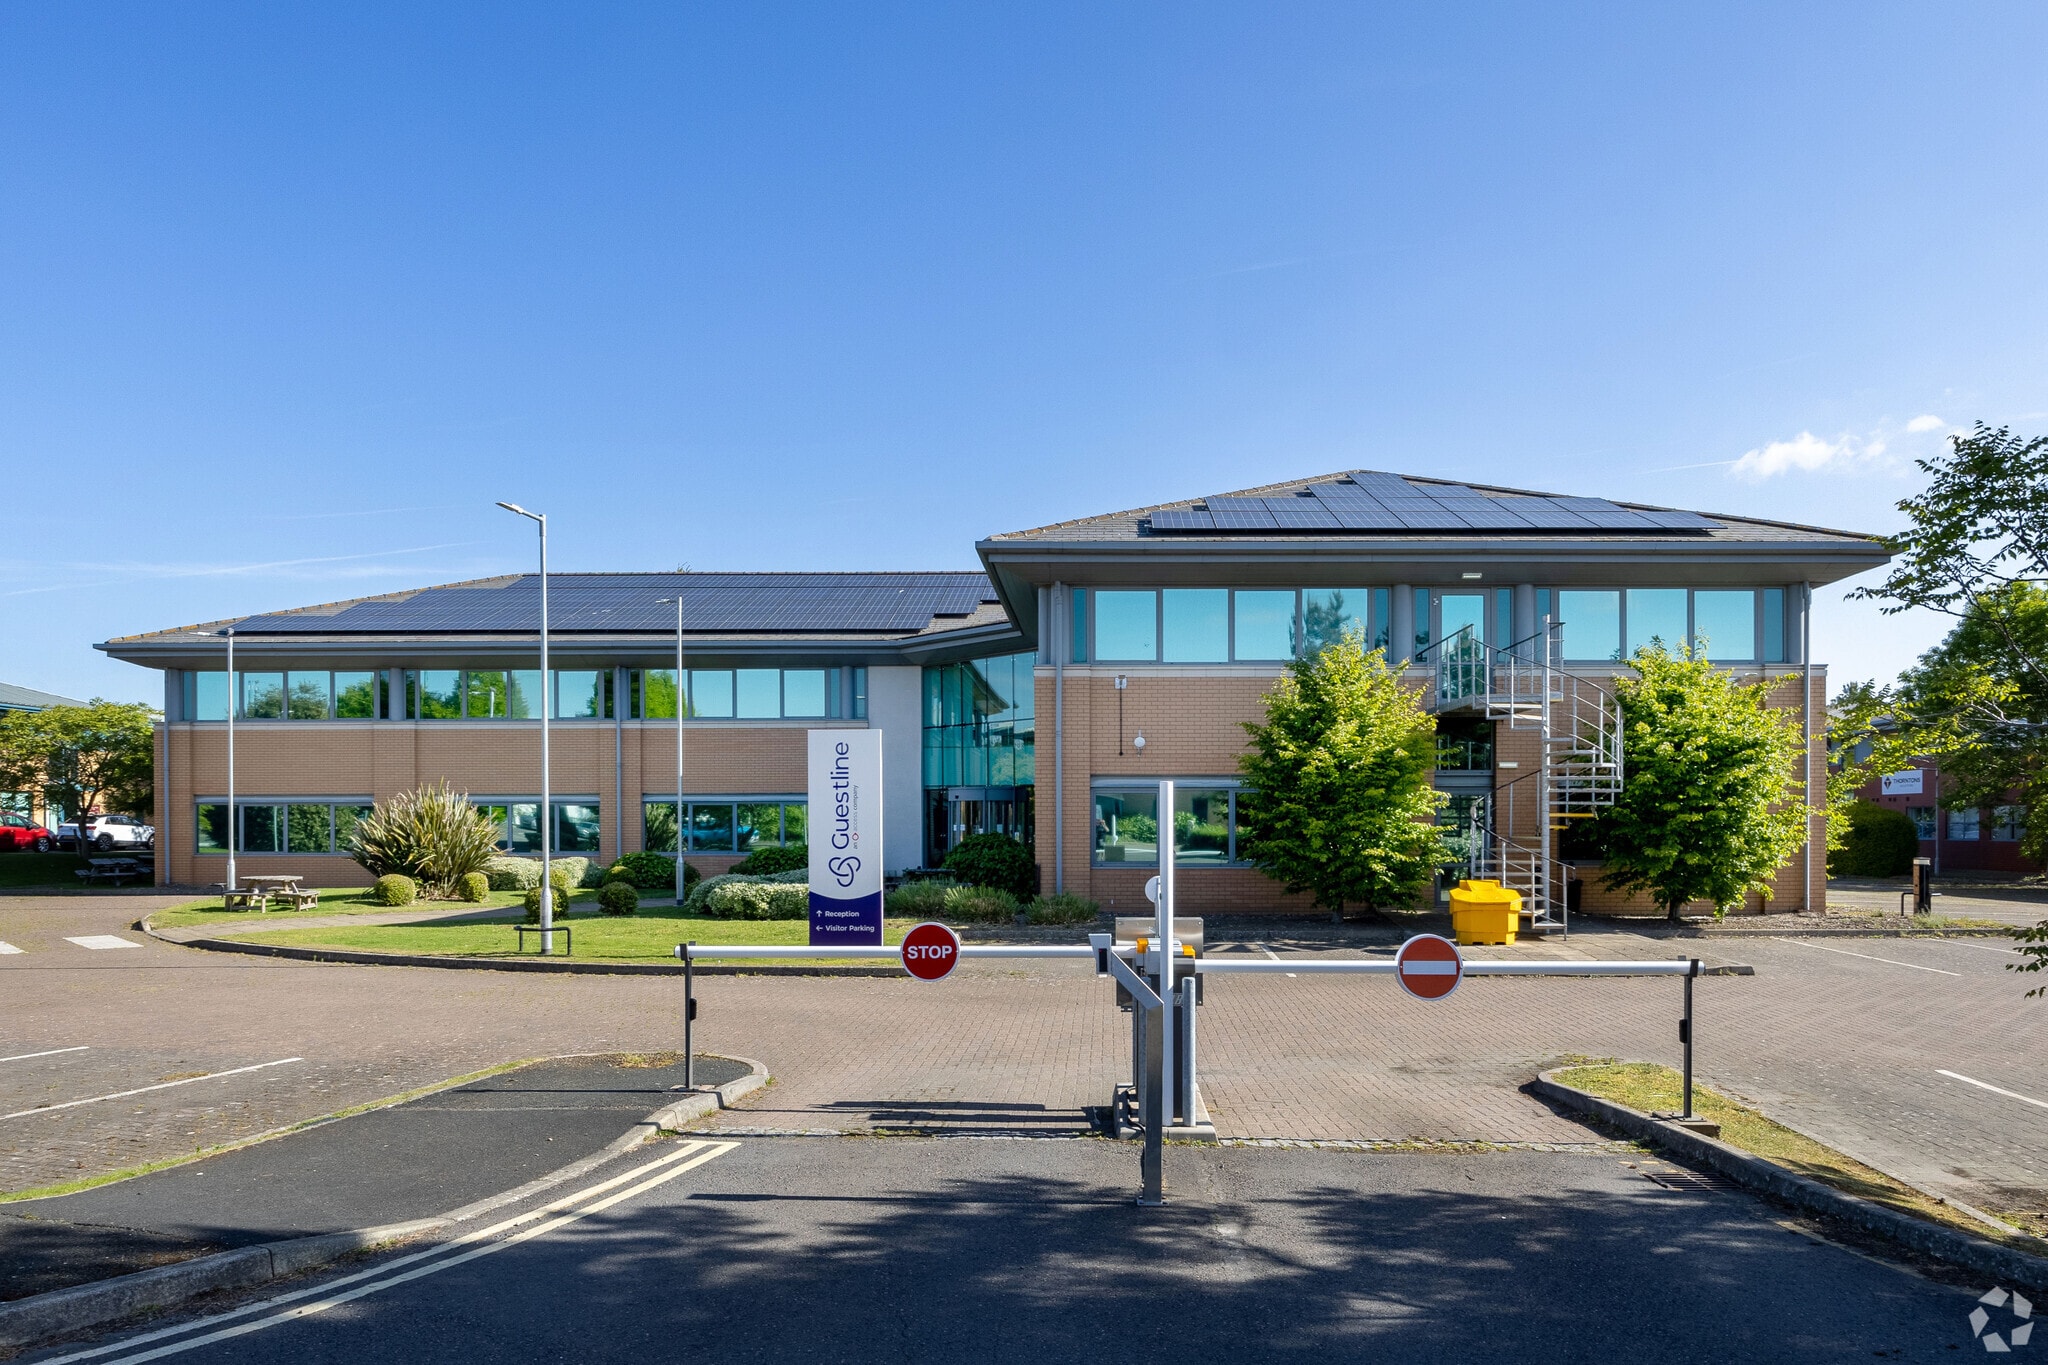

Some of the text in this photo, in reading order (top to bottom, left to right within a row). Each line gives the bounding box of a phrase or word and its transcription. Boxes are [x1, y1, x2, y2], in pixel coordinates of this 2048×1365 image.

[830, 742, 849, 850] Guestline
[853, 842, 858, 850] an
[824, 910, 860, 918] Reception
[849, 925, 875, 933] Parking
[907, 945, 953, 959] STOP
